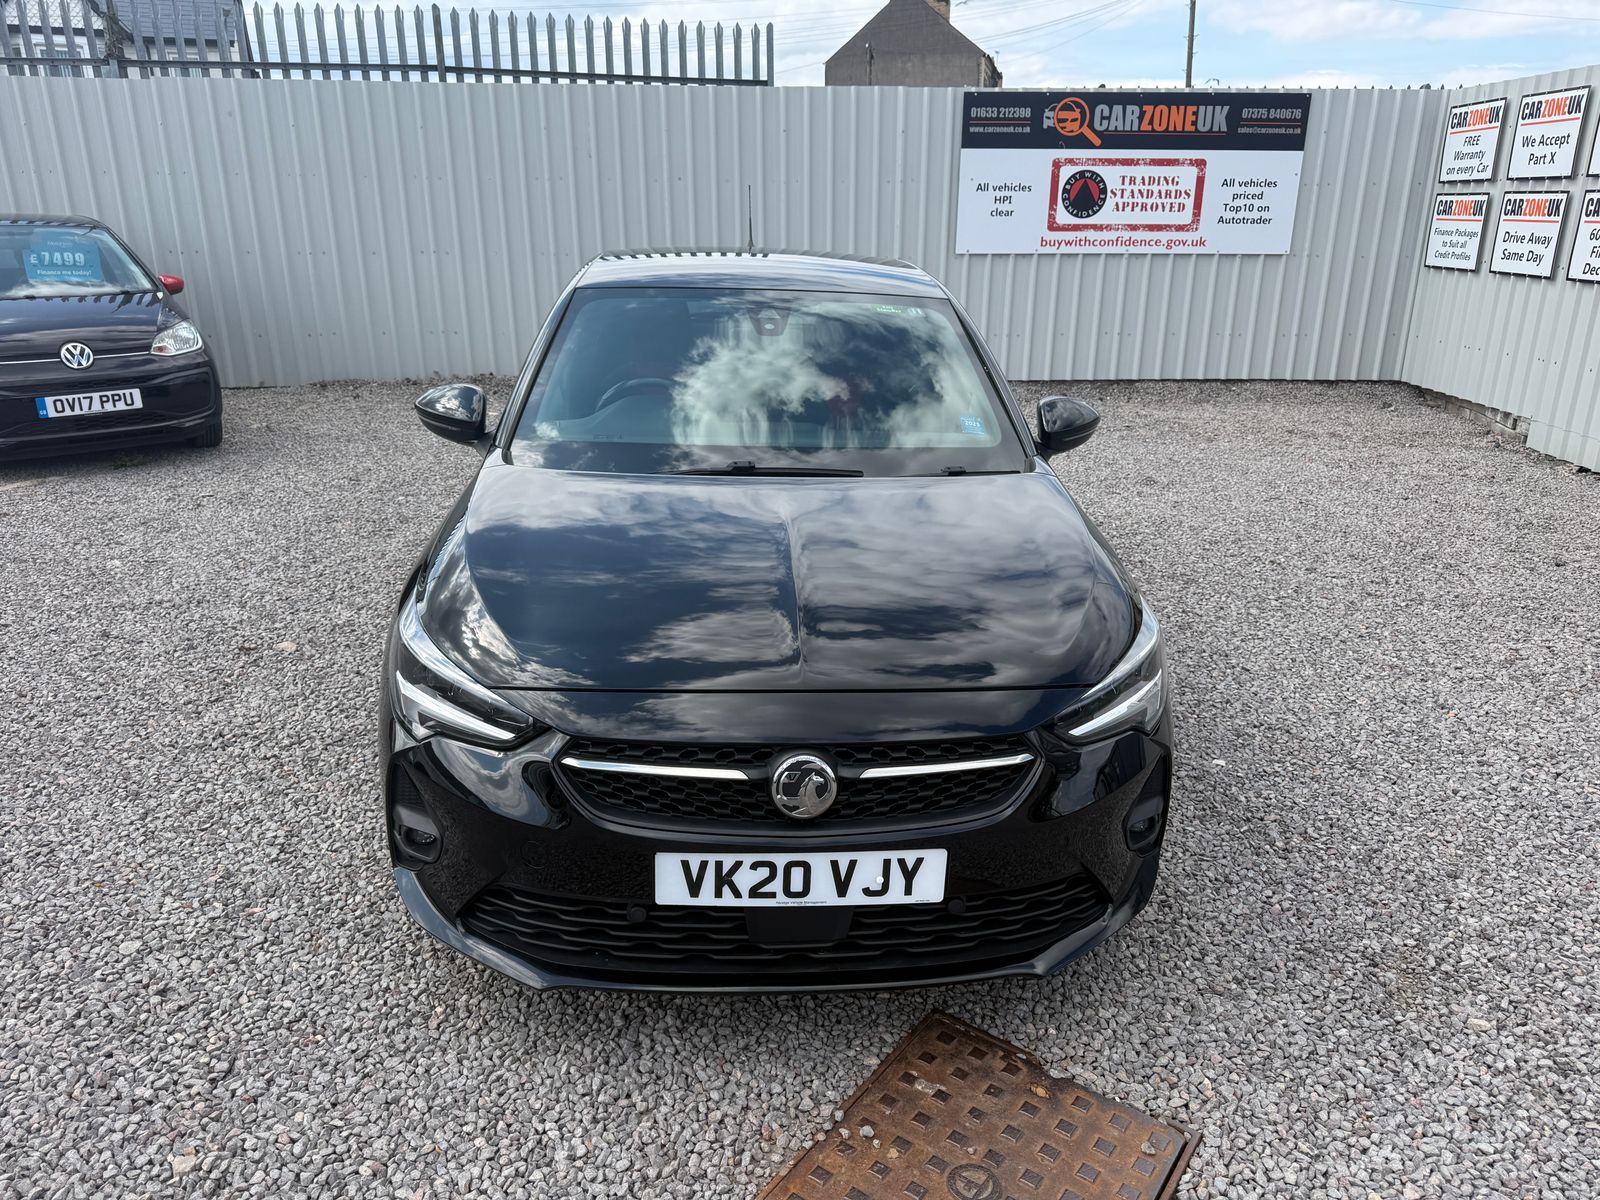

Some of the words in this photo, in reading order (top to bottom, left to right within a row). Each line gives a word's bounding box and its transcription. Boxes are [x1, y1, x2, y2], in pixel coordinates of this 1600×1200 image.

[971, 107, 997, 118] 01633
[999, 107, 1031, 118] 212398
[1242, 107, 1268, 119] 07375
[1268, 108, 1302, 120] 840676
[1521, 93, 1584, 121] CARZONEUK
[1093, 104, 1230, 132] CARZONEUK
[1450, 105, 1502, 130] CARZONEUK
[1463, 134, 1482, 147] FREE
[1521, 135, 1536, 148] We
[1538, 133, 1570, 149] Accept
[1453, 149, 1486, 161] Warranty
[1528, 152, 1547, 166] Part
[1548, 151, 1557, 164] X
[1446, 167, 1456, 175] on
[1456, 164, 1475, 176] every
[1476, 162, 1489, 173] Car
[976, 183, 989, 192] All
[992, 182, 1032, 192] vehicles
[1065, 173, 1081, 190] BUY
[1084, 171, 1105, 189] WITH
[1120, 175, 1180, 187] TRADING
[1221, 178, 1235, 188] All
[1238, 178, 1278, 188] vehicles
[994, 195, 1012, 204] HPI
[1109, 188, 1192, 200] STANDARDS
[1232, 190, 1264, 202] priced
[1062, 193, 1106, 217] CONFIDENCE
[1112, 201, 1186, 213] APPROVED
[1223, 203, 1254, 215] Top10
[1436, 199, 1486, 217] CARZONEUK
[1503, 198, 1563, 217] CARZONEUK
[990, 207, 1014, 217] clear
[1217, 216, 1272, 225] Autotrader
[1433, 227, 1454, 236] Finance
[1454, 228, 1479, 240] Packages
[1502, 231, 1526, 244] Drive
[1527, 232, 1553, 249] Away
[1040, 236, 1207, 250] buywithconfidence.gov.uk
[1448, 239, 1459, 248] Suit
[1434, 250, 1451, 260] Credit
[1451, 251, 1471, 261] Profiles
[1501, 248, 1525, 262] Same
[1526, 250, 1545, 267] Day
[52, 395, 93, 414] OV17
[99, 391, 135, 410] PPU
[680, 860, 812, 899] VK20
[829, 857, 925, 899] VJY
